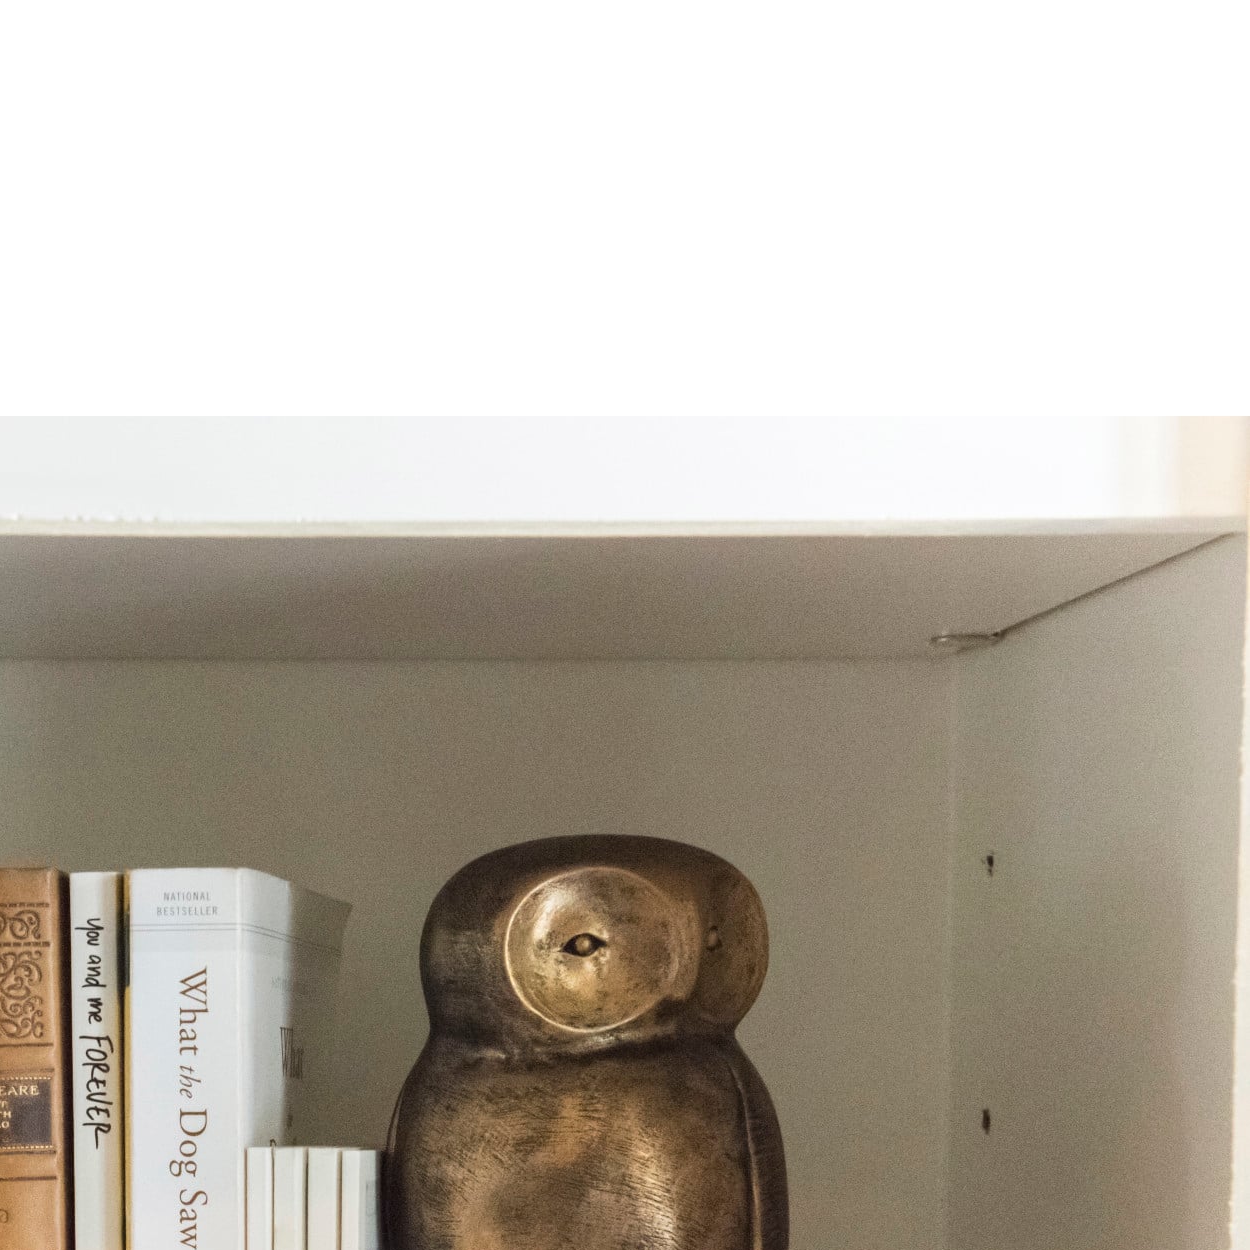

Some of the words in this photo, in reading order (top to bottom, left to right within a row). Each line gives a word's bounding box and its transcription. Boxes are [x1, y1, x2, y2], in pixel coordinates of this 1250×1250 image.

[156, 906, 218, 916] BESTSELLER
[163, 891, 211, 901] NATIONAL
[82, 954, 107, 988] and
[87, 997, 104, 1024] me
[178, 965, 209, 1056] What
[79, 1035, 114, 1150] FOREVER
[179, 1063, 202, 1099] the
[169, 1107, 208, 1178] Dog
[178, 1189, 208, 1250] Saw
